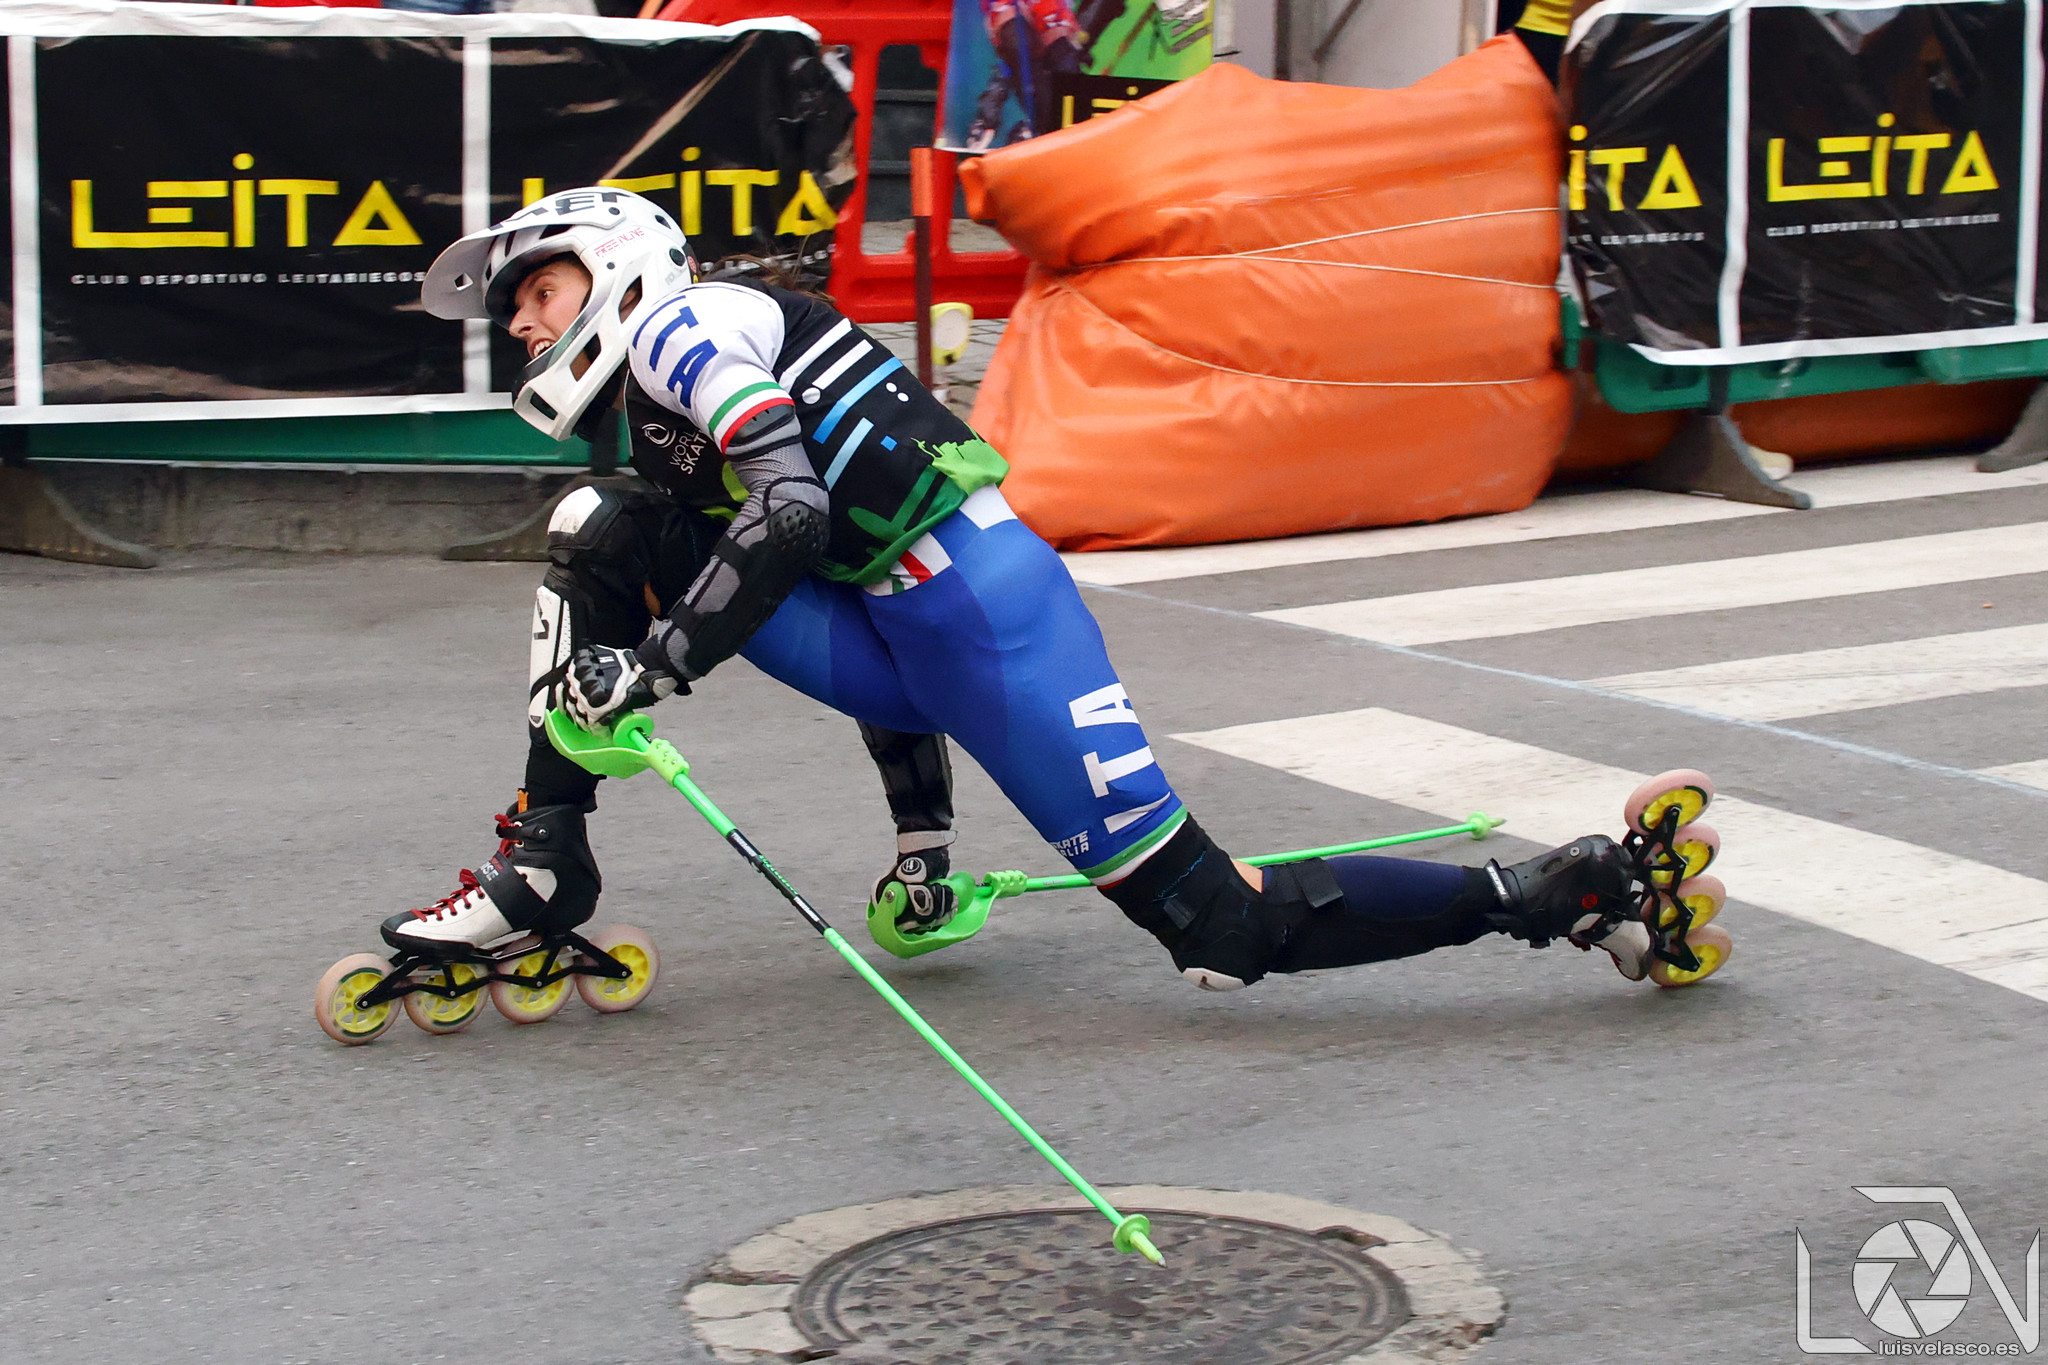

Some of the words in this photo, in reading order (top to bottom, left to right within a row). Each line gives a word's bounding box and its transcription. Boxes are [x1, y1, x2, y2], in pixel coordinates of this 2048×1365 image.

[70, 273, 130, 285] CLUB
[669, 431, 696, 466] WORL
[680, 432, 708, 475] SKAT
[1068, 682, 1171, 835] ITA
